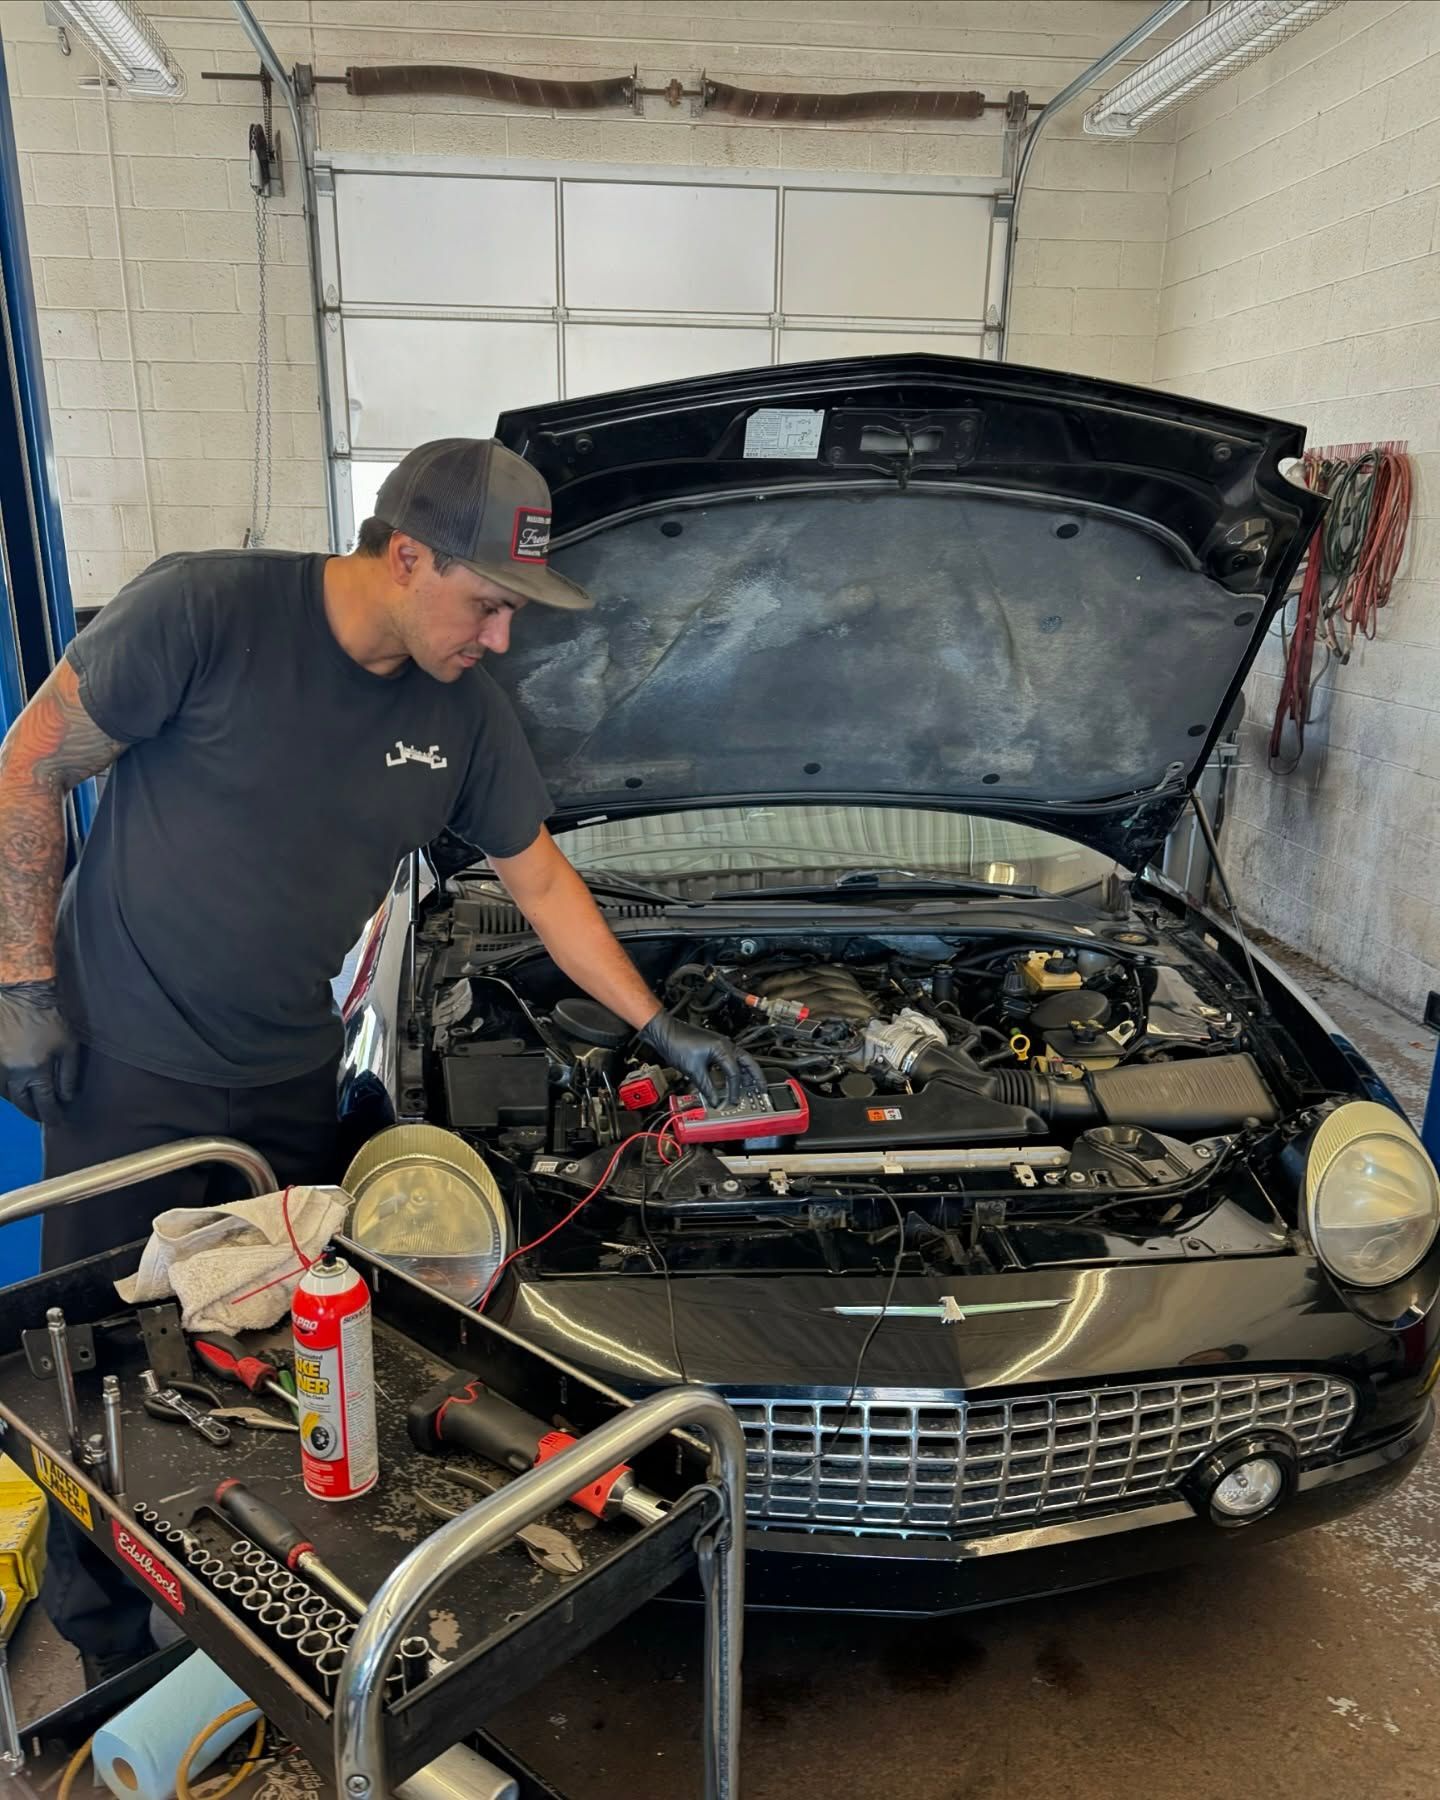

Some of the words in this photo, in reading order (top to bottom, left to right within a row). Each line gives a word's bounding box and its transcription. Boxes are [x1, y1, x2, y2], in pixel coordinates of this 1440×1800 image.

[296, 1358, 321, 1378] AKE
[297, 1374, 329, 1394] NER
[118, 1531, 179, 1601] Edelbrock
